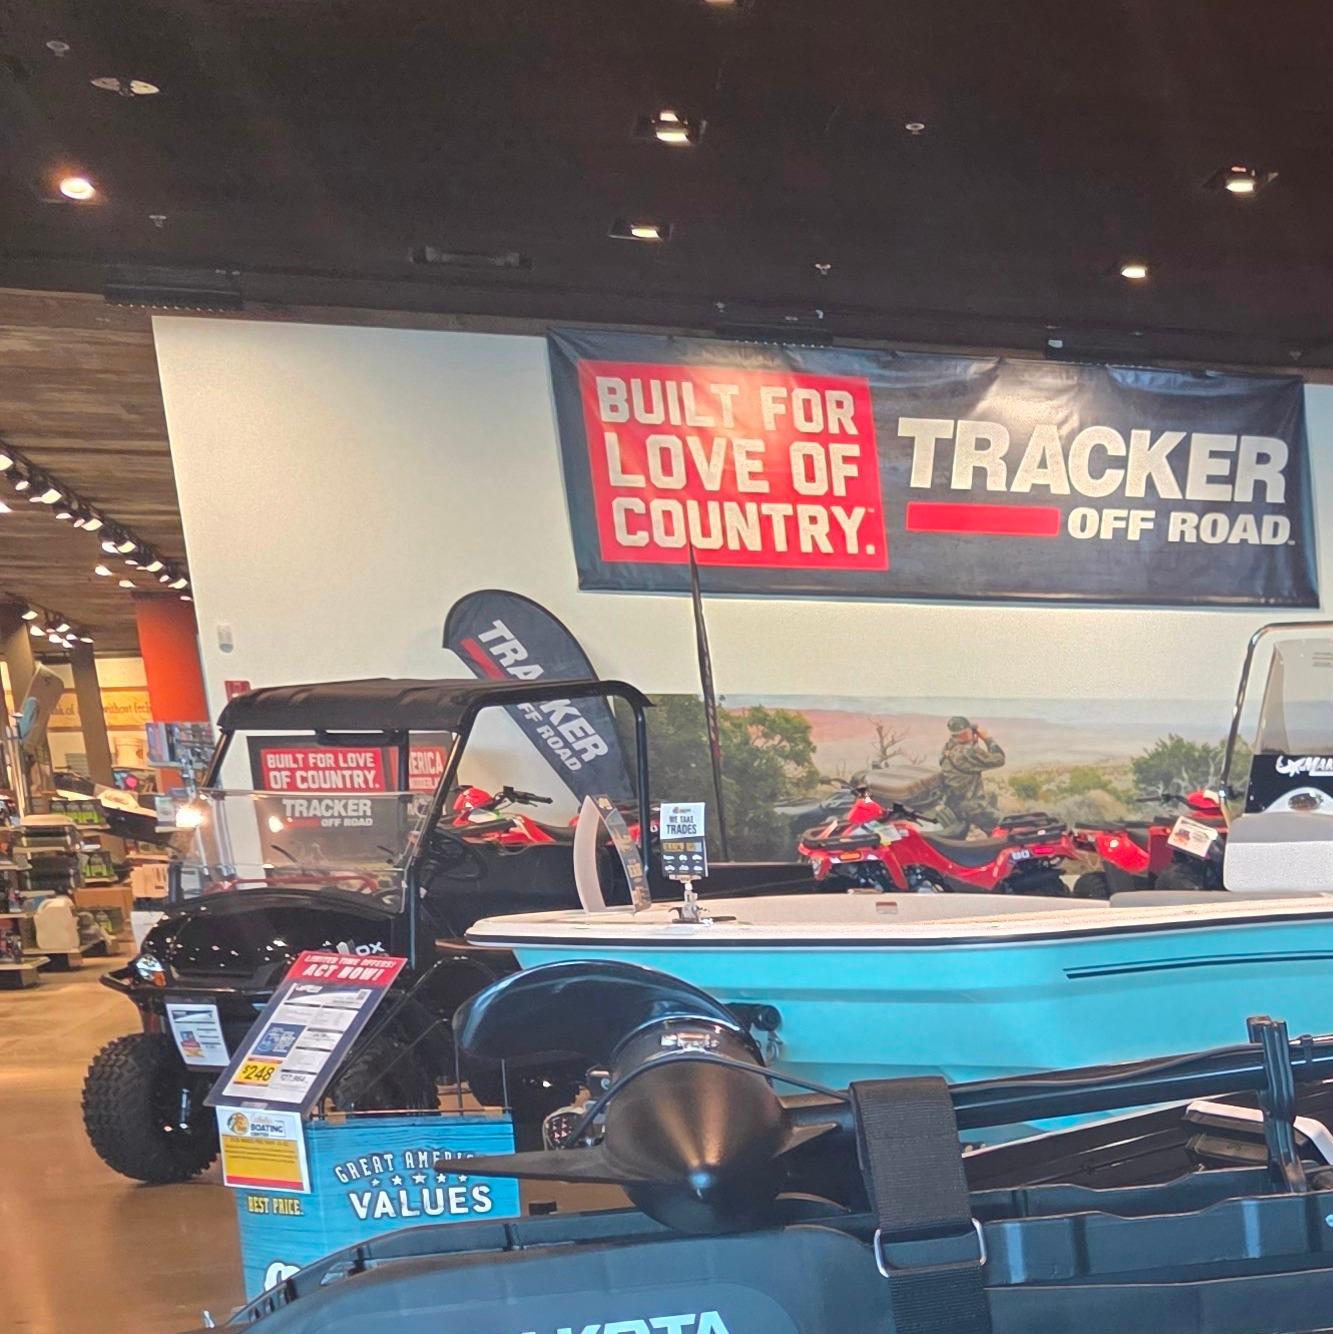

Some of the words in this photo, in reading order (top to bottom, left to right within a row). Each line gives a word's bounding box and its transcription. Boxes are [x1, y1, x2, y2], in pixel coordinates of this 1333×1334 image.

[596, 376, 740, 429] BUILT
[759, 386, 859, 436] FOR
[603, 431, 771, 494] LOVE
[788, 441, 861, 497] OF
[897, 416, 1290, 504] TRACKER
[1067, 506, 1157, 542] OFF
[478, 619, 608, 762] TRAKER
[517, 702, 544, 723] FF
[536, 725, 583, 772] ROAD
[267, 753, 304, 769] BUILT
[309, 752, 334, 767] FOR
[339, 752, 375, 767] LOVE
[269, 771, 291, 790] OF
[295, 770, 381, 790] COUNTRY.
[282, 799, 372, 818] TRACKER
[321, 818, 343, 827] OFF
[343, 818, 374, 827] ROAD
[666, 824, 697, 835] TRADES
[669, 816, 678, 824] WE
[302, 964, 338, 979] ACT
[336, 965, 385, 982] NOW!
[241, 1064, 276, 1083] $248
[250, 1122, 283, 1134] BOATING
[334, 1153, 395, 1184] GREAT
[349, 1185, 493, 1220] VALUES
